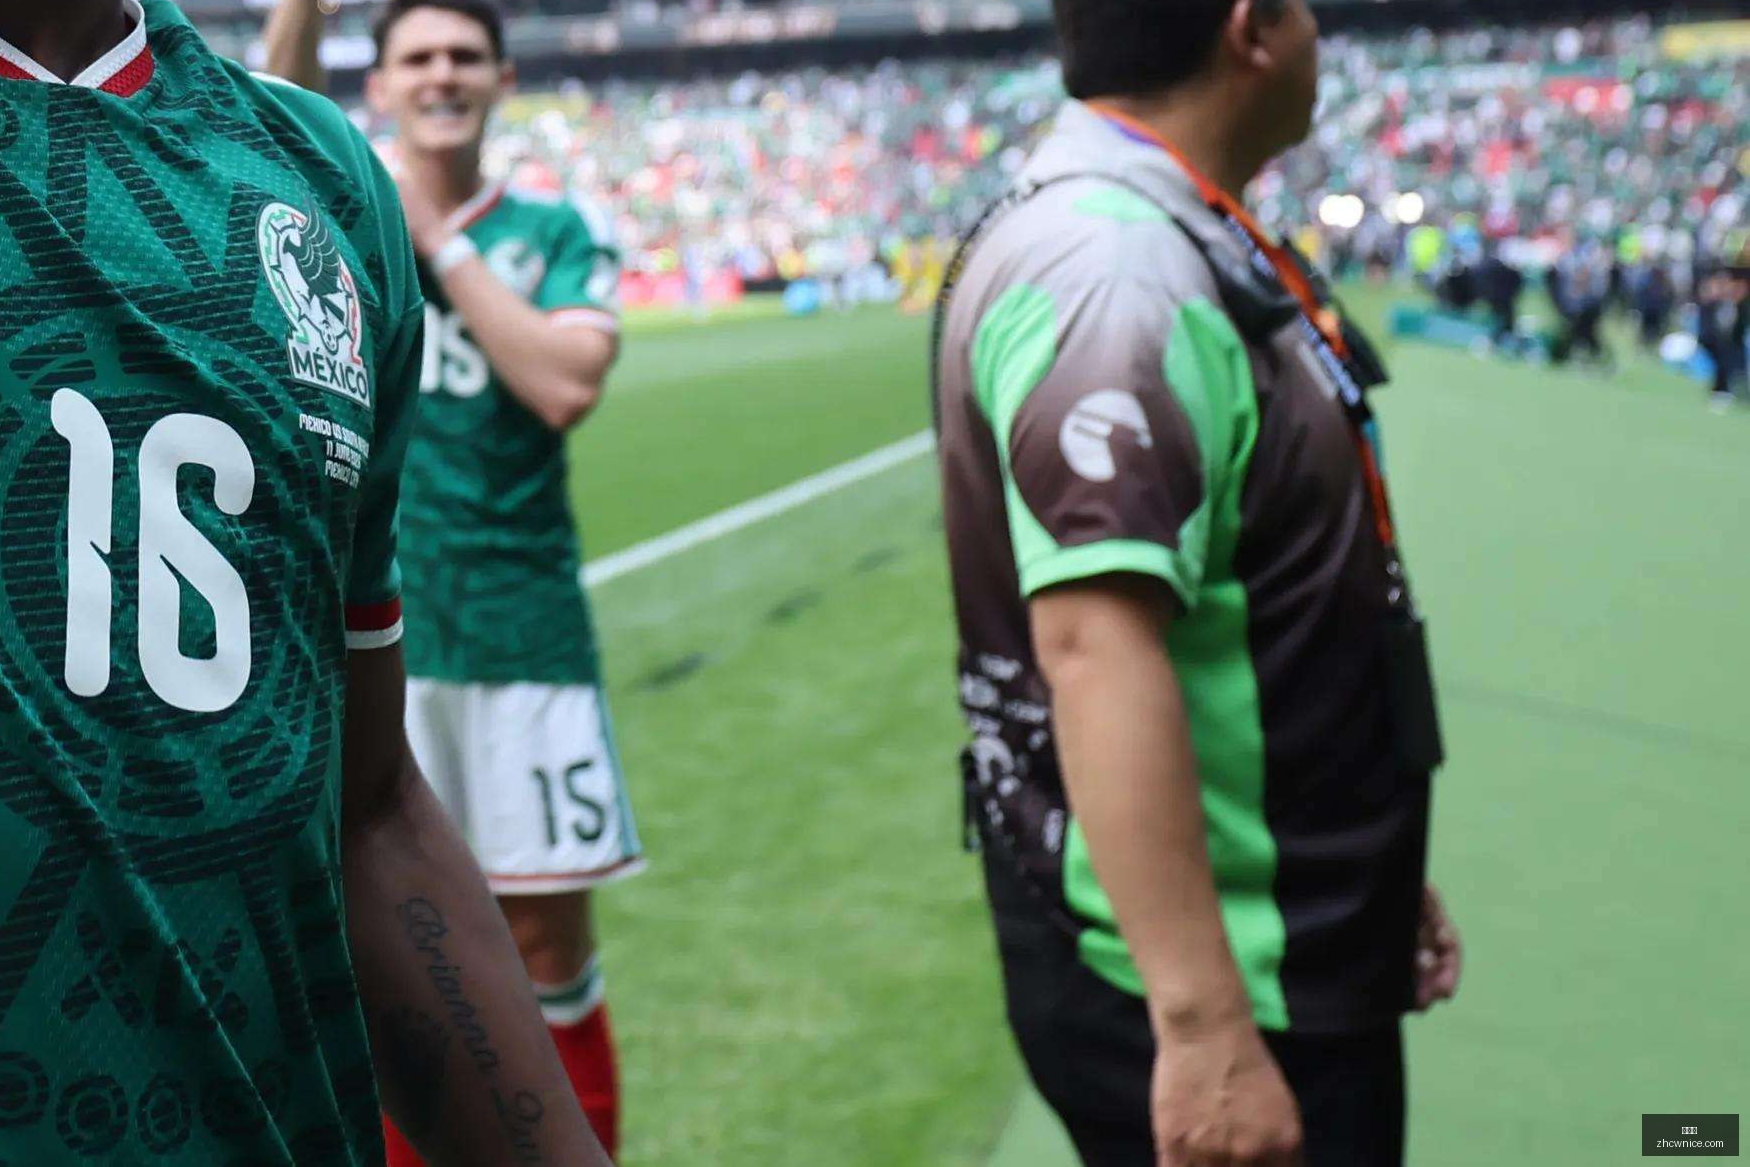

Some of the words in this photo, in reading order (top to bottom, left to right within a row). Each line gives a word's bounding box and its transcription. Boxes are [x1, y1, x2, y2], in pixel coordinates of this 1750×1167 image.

[292, 346, 368, 400] MÉXICO
[420, 301, 489, 398] 15
[51, 387, 255, 713] 16
[531, 760, 606, 847] 15
